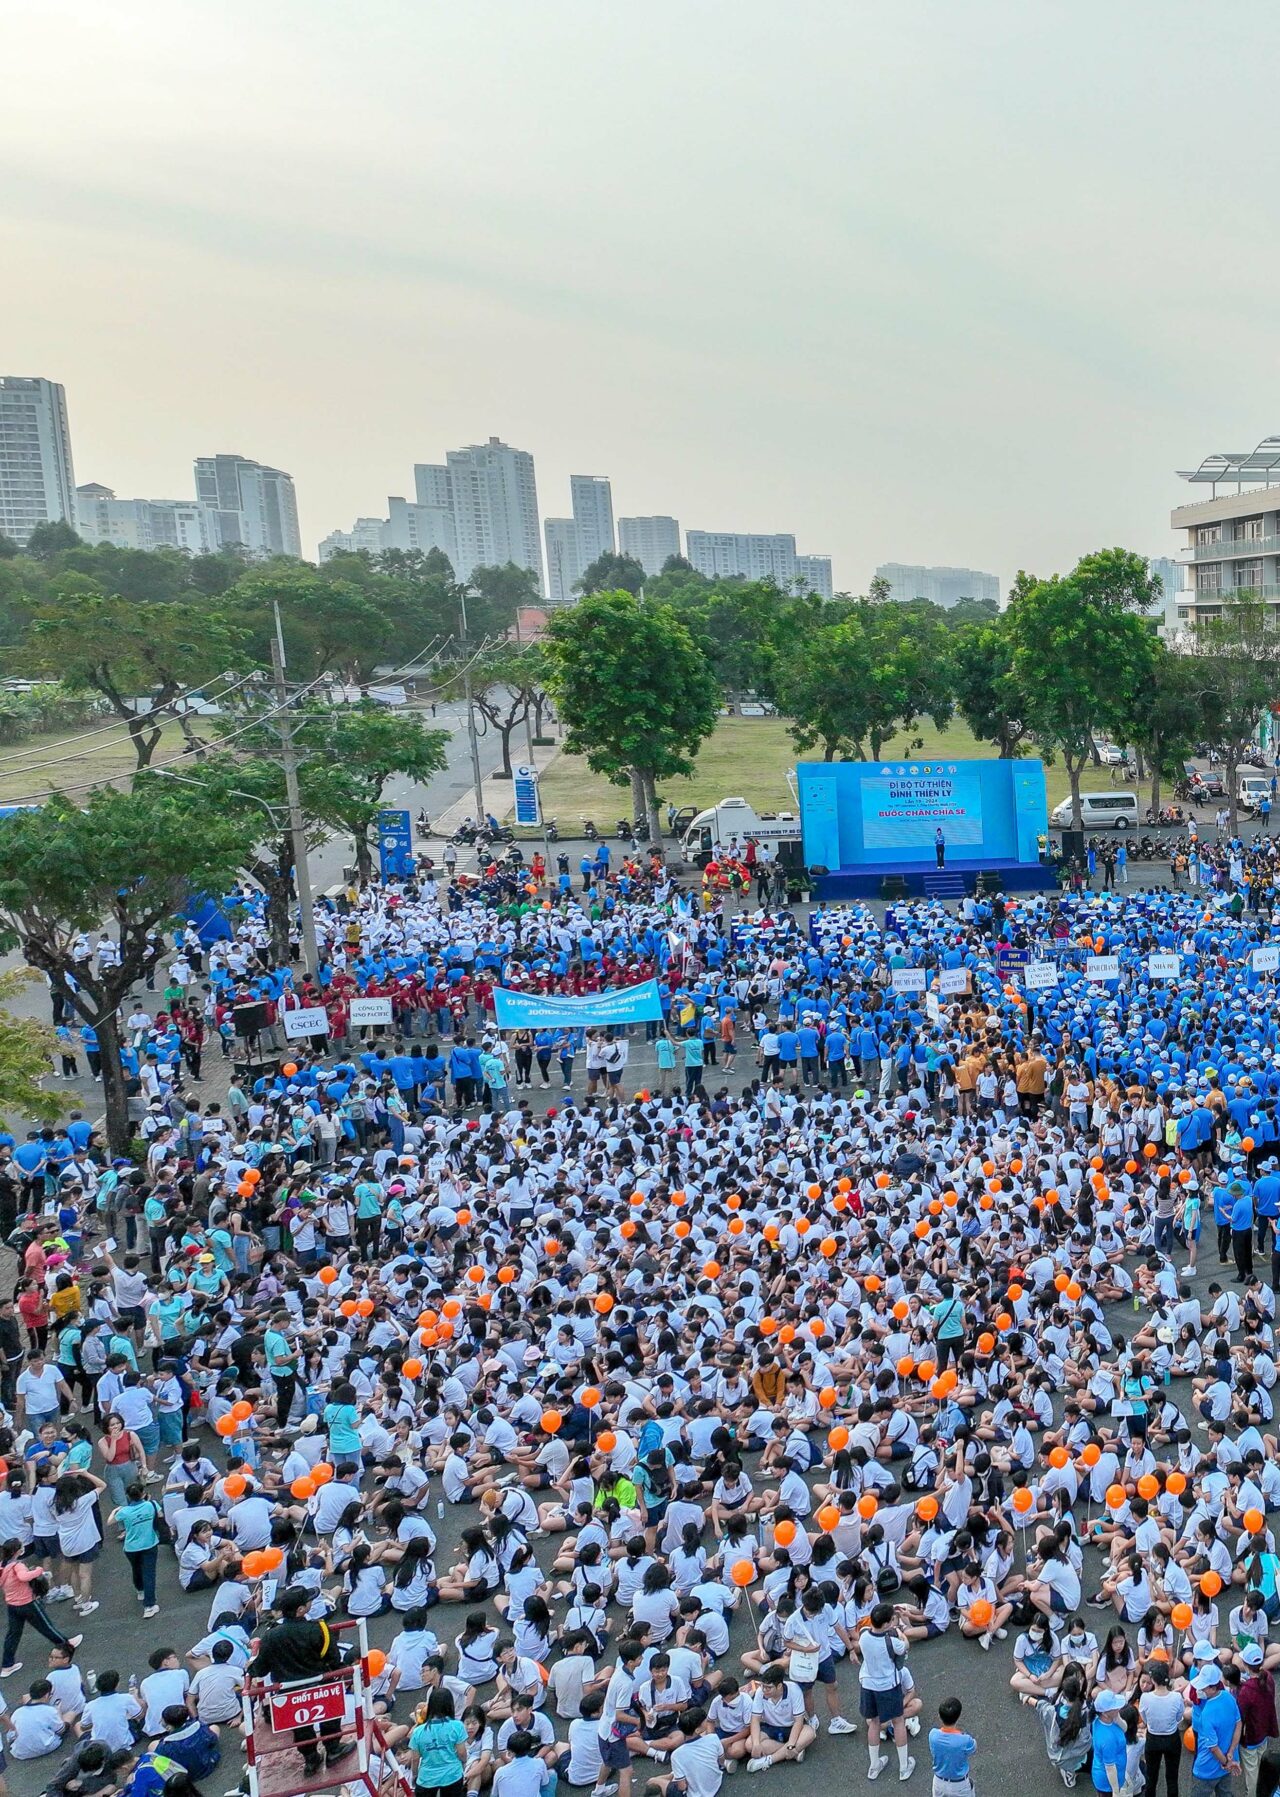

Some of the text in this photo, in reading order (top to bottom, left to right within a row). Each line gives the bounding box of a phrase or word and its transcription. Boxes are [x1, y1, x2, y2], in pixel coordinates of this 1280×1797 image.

[901, 781, 913, 791] BỘ
[928, 780, 952, 789] THIỆN
[915, 789, 940, 798] THIỆN
[291, 1020, 322, 1031] CSCEC
[292, 1686, 341, 1705] CHỐT BẢO VỆ
[294, 1705, 326, 1724] 02
